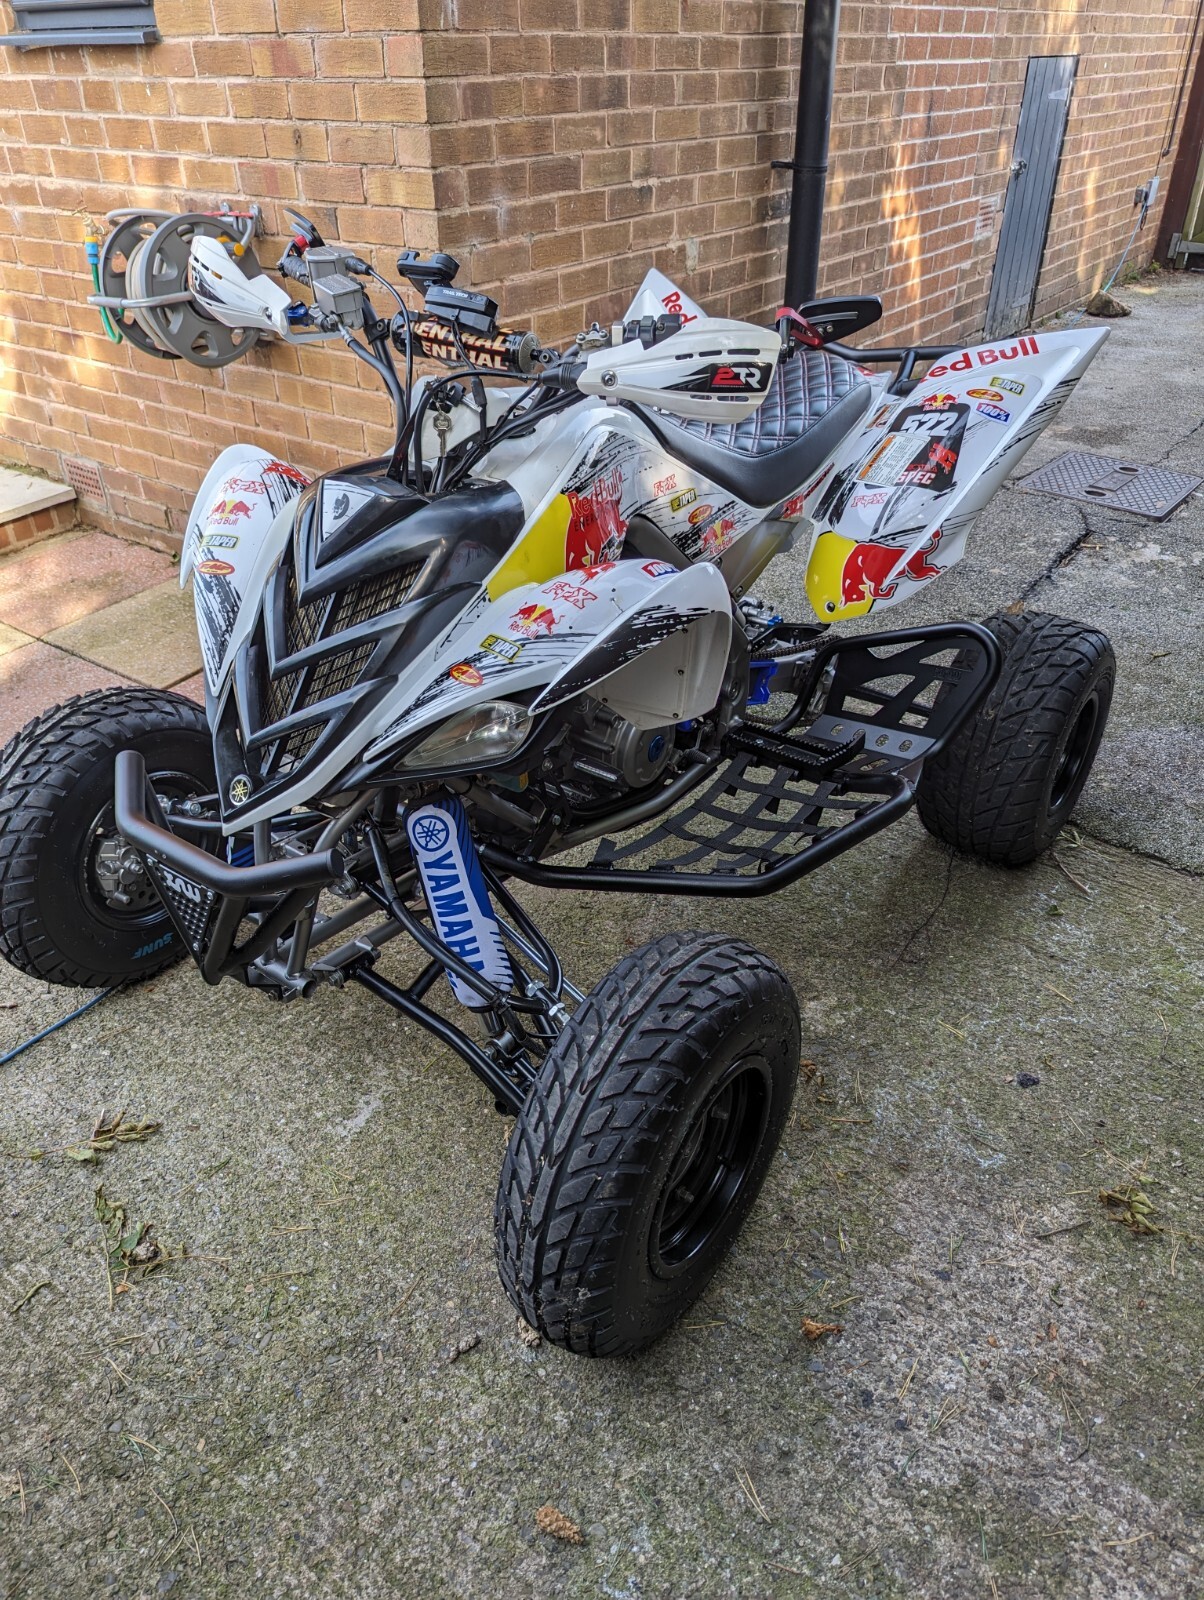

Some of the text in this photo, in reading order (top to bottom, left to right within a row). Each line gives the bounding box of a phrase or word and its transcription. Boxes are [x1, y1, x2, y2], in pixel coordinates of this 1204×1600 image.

[919, 336, 1039, 383] ed Bull
[978, 404, 1008, 421] 100%
[900, 412, 959, 437] 522
[896, 471, 937, 485] SPEC
[566, 479, 600, 520] Red
[223, 516, 240, 526] Bull
[208, 535, 238, 548] TAPER
[508, 620, 540, 641] Red Bull
[490, 638, 520, 659] TAPER
